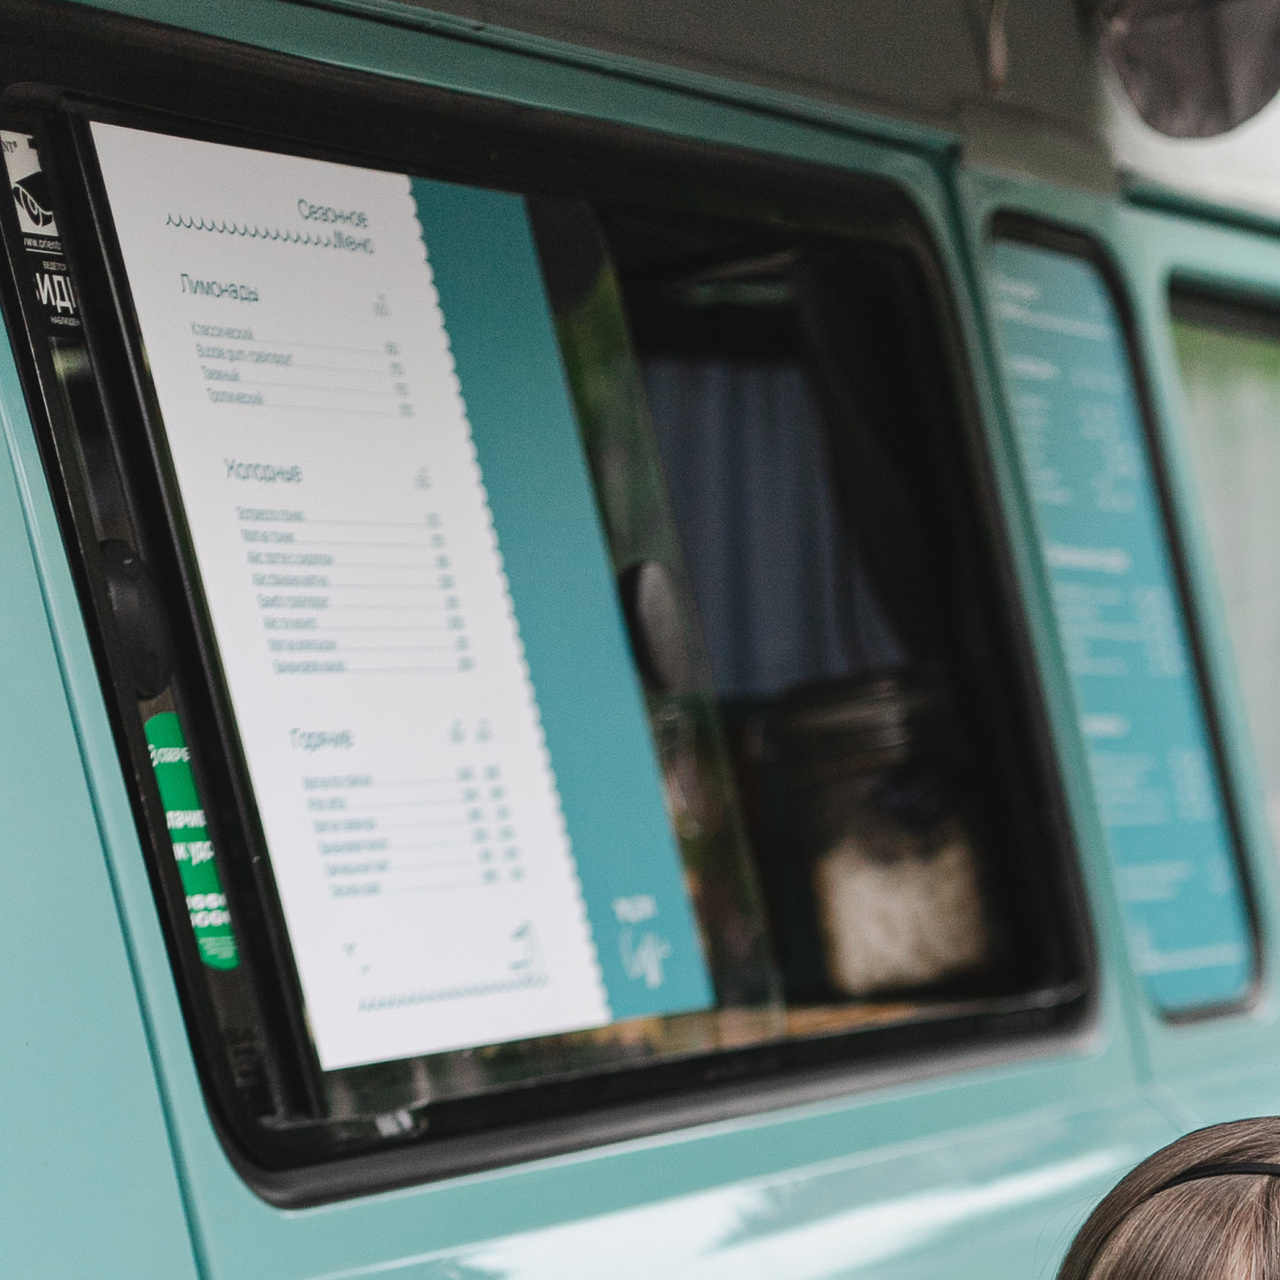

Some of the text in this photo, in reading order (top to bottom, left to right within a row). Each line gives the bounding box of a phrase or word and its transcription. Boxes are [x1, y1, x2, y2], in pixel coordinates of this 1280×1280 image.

[298, 199, 369, 228] Сезонное
[181, 273, 259, 301] Лимонады
[224, 458, 303, 483] Холодные
[290, 727, 353, 751] Горячие
